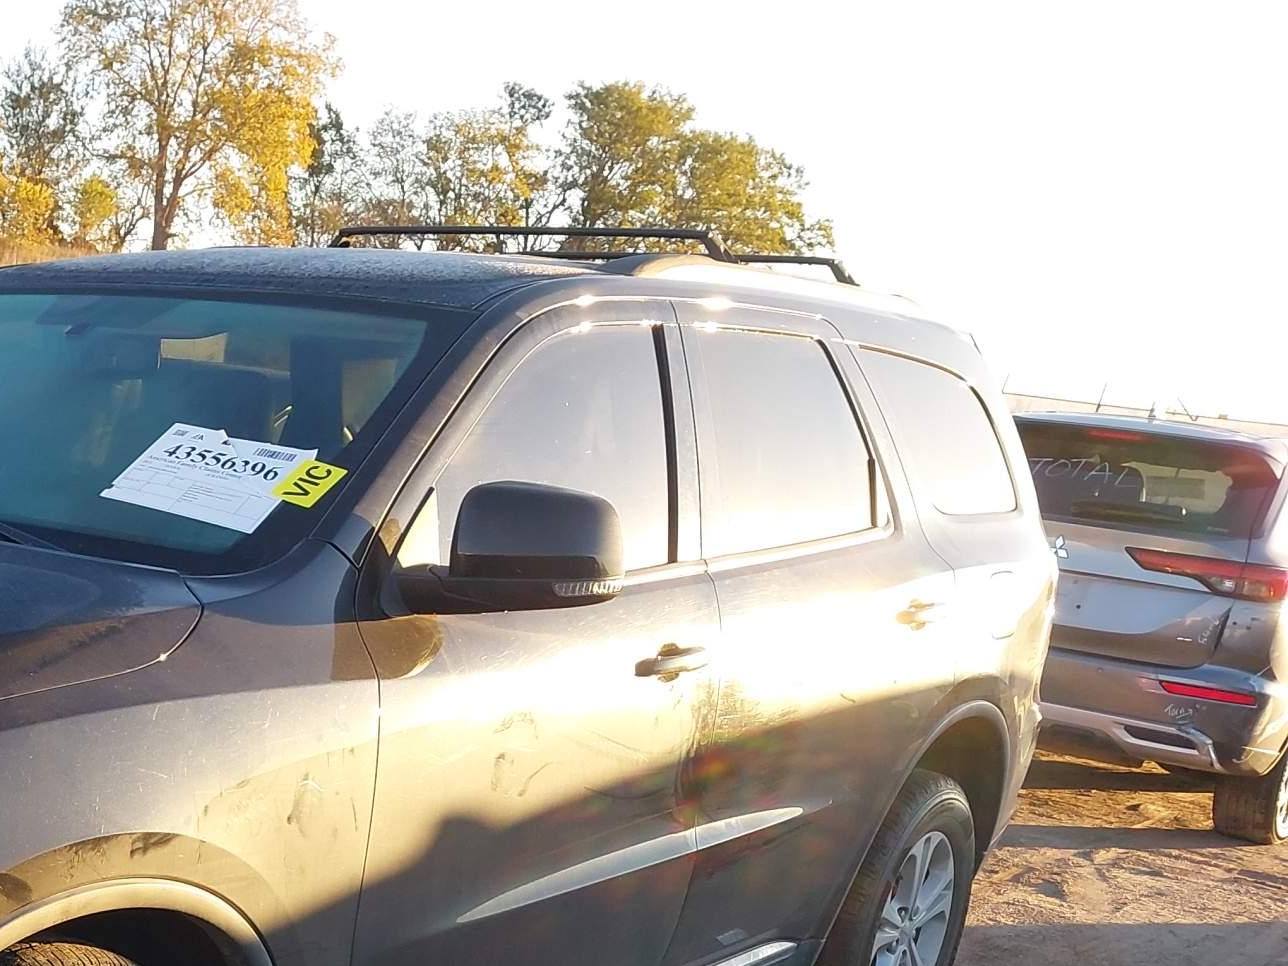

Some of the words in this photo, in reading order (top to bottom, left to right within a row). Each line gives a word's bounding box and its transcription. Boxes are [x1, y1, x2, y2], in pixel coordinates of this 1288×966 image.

[163, 444, 285, 482] 43556396
[1029, 457, 1137, 488] TOTAL
[281, 465, 332, 497] VIC
